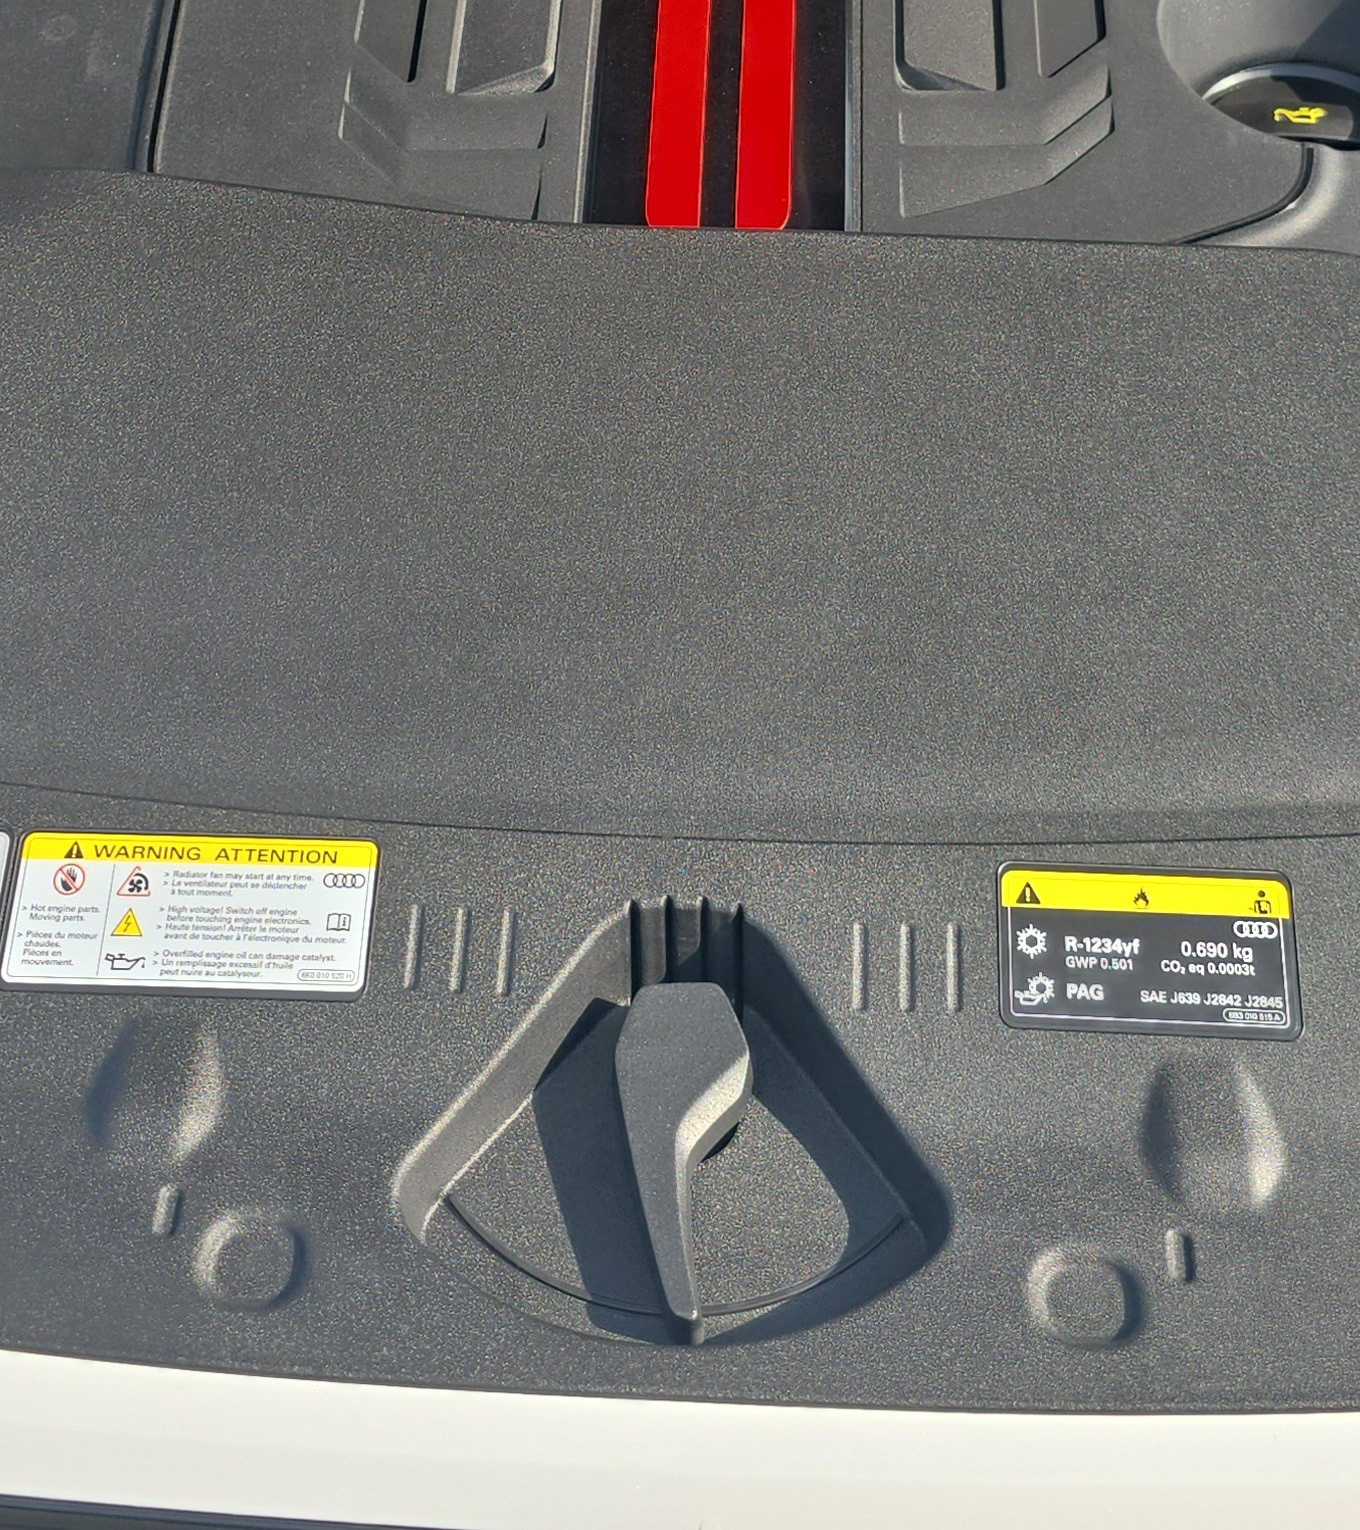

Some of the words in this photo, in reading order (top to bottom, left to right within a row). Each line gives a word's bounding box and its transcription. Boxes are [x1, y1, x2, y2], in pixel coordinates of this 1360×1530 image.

[93, 844, 201, 861] WARNING
[214, 847, 338, 864] ATTENTION
[173, 870, 208, 878] Radiator
[225, 872, 243, 881] may
[276, 874, 291, 882] any
[171, 879, 181, 887] Le
[183, 880, 228, 888] ventilateur
[229, 881, 249, 889] peut
[261, 881, 307, 890] déclencher
[30, 903, 46, 912] Hot
[47, 905, 76, 913] engine
[167, 904, 188, 914] High
[189, 906, 224, 915] voltage!
[225, 906, 254, 915] Switch
[255, 907, 268, 915] off
[268, 909, 298, 917] engine
[29, 912, 60, 922] Moving
[166, 914, 194, 922] before
[195, 915, 232, 925] touching
[233, 917, 263, 925] engine
[165, 922, 190, 931] Haute
[192, 923, 226, 931] tension!
[269, 926, 299, 934] moteur
[26, 930, 52, 939] Pièces
[54, 931, 65, 939] du
[67, 932, 98, 940] moteur
[164, 932, 188, 940] avant
[188, 932, 200, 940] de
[202, 933, 234, 941] toucher
[301, 935, 313, 943] du
[24, 939, 61, 948] chaudes.
[1064, 935, 1140, 958] R-1234yf
[22, 948, 49, 957] Pièces
[162, 949, 204, 958] Overfilled
[205, 951, 234, 960] engine
[265, 952, 300, 962] damage
[301, 953, 336, 963] catalyst.
[1180, 941, 1228, 958] 0.690
[1232, 942, 1253, 963] kg
[21, 958, 74, 966] mouvement.
[161, 958, 174, 967] Un
[175, 959, 227, 969] remplissage
[229, 960, 263, 968] excessif
[1065, 955, 1098, 969] GWP
[1100, 957, 1133, 971] 0.501
[159, 968, 179, 977] peut
[1188, 963, 1205, 976] eq
[1207, 962, 1256, 976] 0.0003t
[1066, 982, 1105, 1001] PAG
[1140, 990, 1167, 1004] SAE
[1170, 991, 1201, 1005] J639
[1203, 992, 1242, 1007] J2842
[1244, 995, 1284, 1009] J2845
